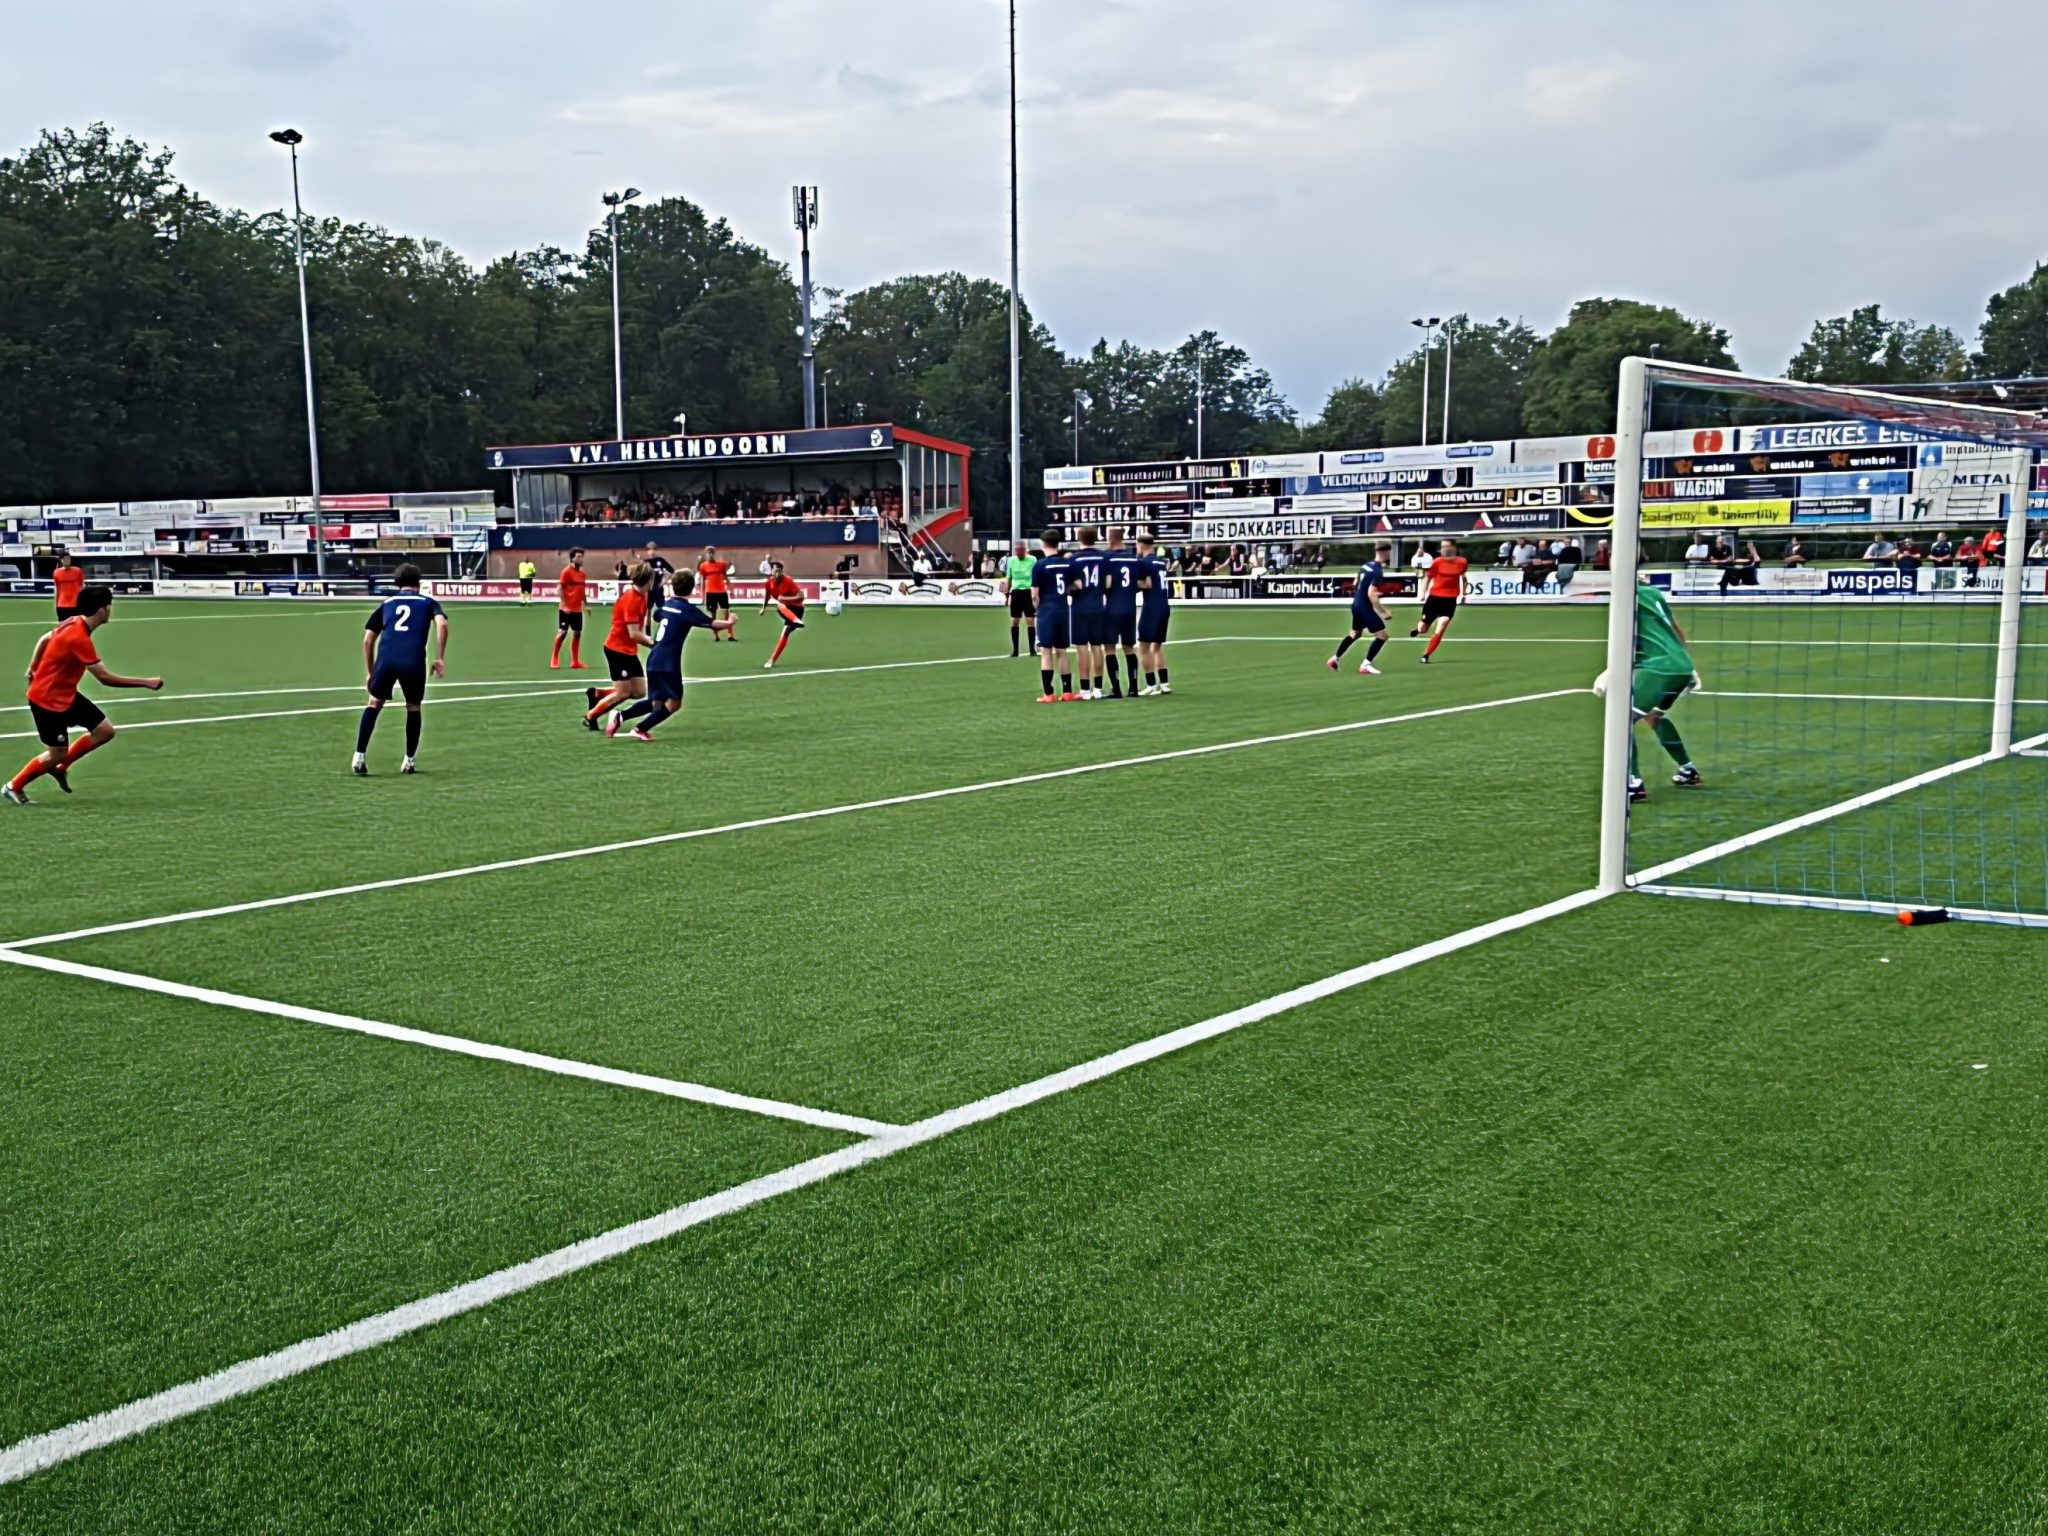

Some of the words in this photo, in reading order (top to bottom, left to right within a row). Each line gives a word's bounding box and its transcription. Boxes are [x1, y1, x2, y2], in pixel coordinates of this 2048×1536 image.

[1770, 425, 1867, 448] LEERKES
[570, 445, 608, 462] V.V.
[620, 434, 786, 461] HELLENDOORN
[1320, 472, 1387, 487] VELDKAMP
[1388, 469, 1429, 484] BOUW
[1372, 494, 1422, 511] JCB
[1508, 488, 1561, 506] JCB
[1206, 522, 1225, 538] HS
[1228, 518, 1326, 537] DAKKAPELLEN
[1055, 573, 1066, 595] 5
[1082, 564, 1099, 587] 14
[1120, 566, 1130, 587] 3
[1831, 570, 1913, 594] wispels
[394, 604, 411, 632] 2
